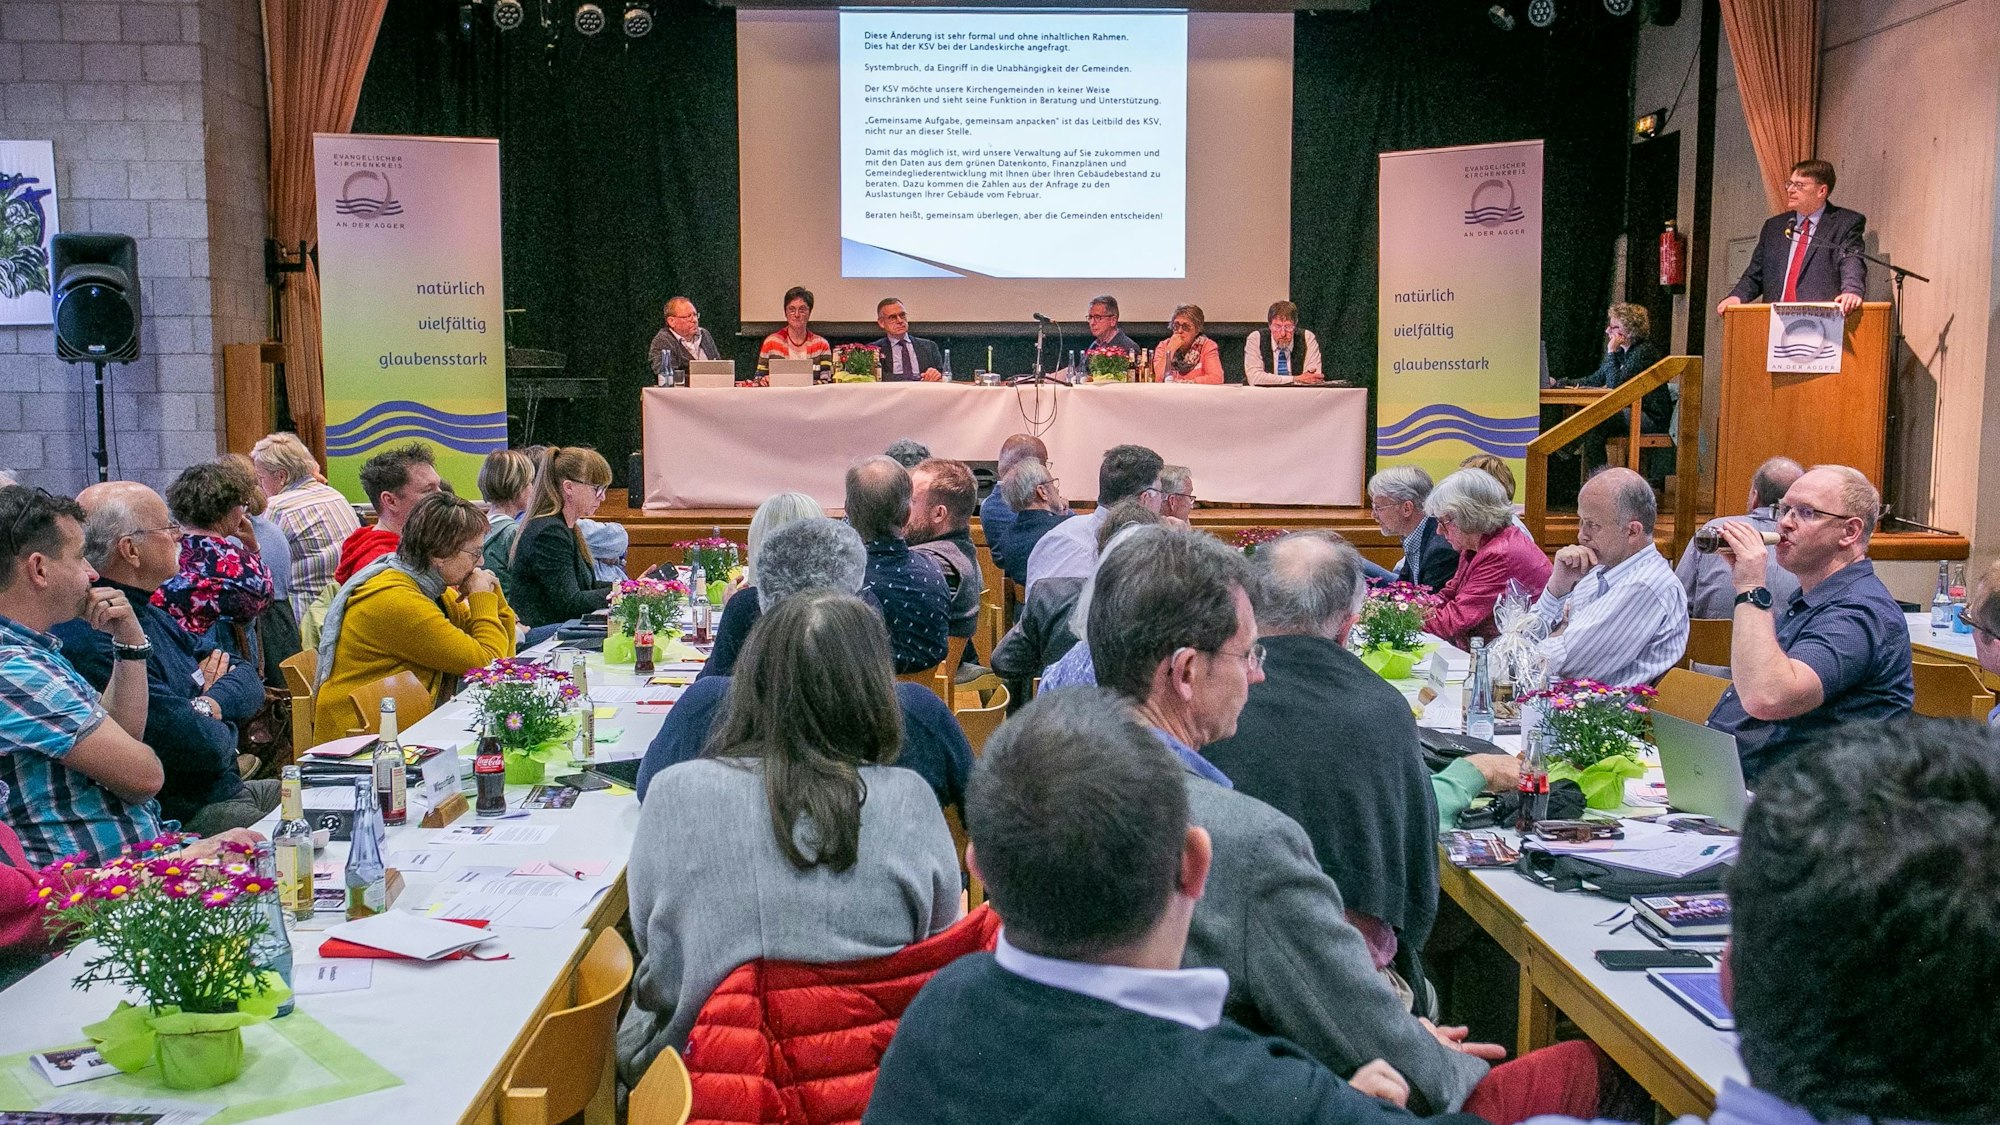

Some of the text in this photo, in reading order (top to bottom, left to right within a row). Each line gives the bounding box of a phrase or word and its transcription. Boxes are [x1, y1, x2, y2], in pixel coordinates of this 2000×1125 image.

[890, 31, 932, 41] Änderung
[968, 32, 996, 40] formal
[969, 43, 1025, 51] Landeskirche
[1027, 43, 1070, 53] angefragt.
[864, 63, 922, 72] Systembruch,
[937, 64, 968, 73] Eingriff
[996, 64, 1062, 74] Unabhängigkeit
[966, 85, 1044, 94] Kirchengemeinden
[990, 96, 1027, 104] Funktion
[1040, 96, 1078, 106] Beratung
[1099, 97, 1161, 106] Unterstützung.
[924, 116, 962, 126] Aufgabe,
[1143, 118, 1162, 126] KSV,
[334, 154, 402, 162] EVANGELISCHER
[910, 148, 944, 158] möglich
[1014, 149, 1061, 158] Verwaltung
[966, 160, 996, 168] grünen
[998, 159, 1049, 167] Datenkonto,
[1052, 160, 1108, 169] Finanzplänen
[1464, 162, 1526, 172] EVANGELISCHER
[865, 169, 987, 179] Gemeindegliederentwicklung
[1464, 169, 1526, 178] KIRCHENKREIS
[1046, 180, 1079, 190] Anfrage
[865, 190, 922, 200] Auslastungen
[900, 211, 923, 219] heißt,
[977, 212, 1021, 221] überlegen,
[416, 282, 485, 295] natürlich
[1394, 289, 1454, 303] natürlich
[419, 317, 486, 333] vielfältig
[1394, 324, 1454, 339] vielfältig
[379, 352, 488, 369] glaubensstark
[1393, 357, 1489, 374] glaubensstark
